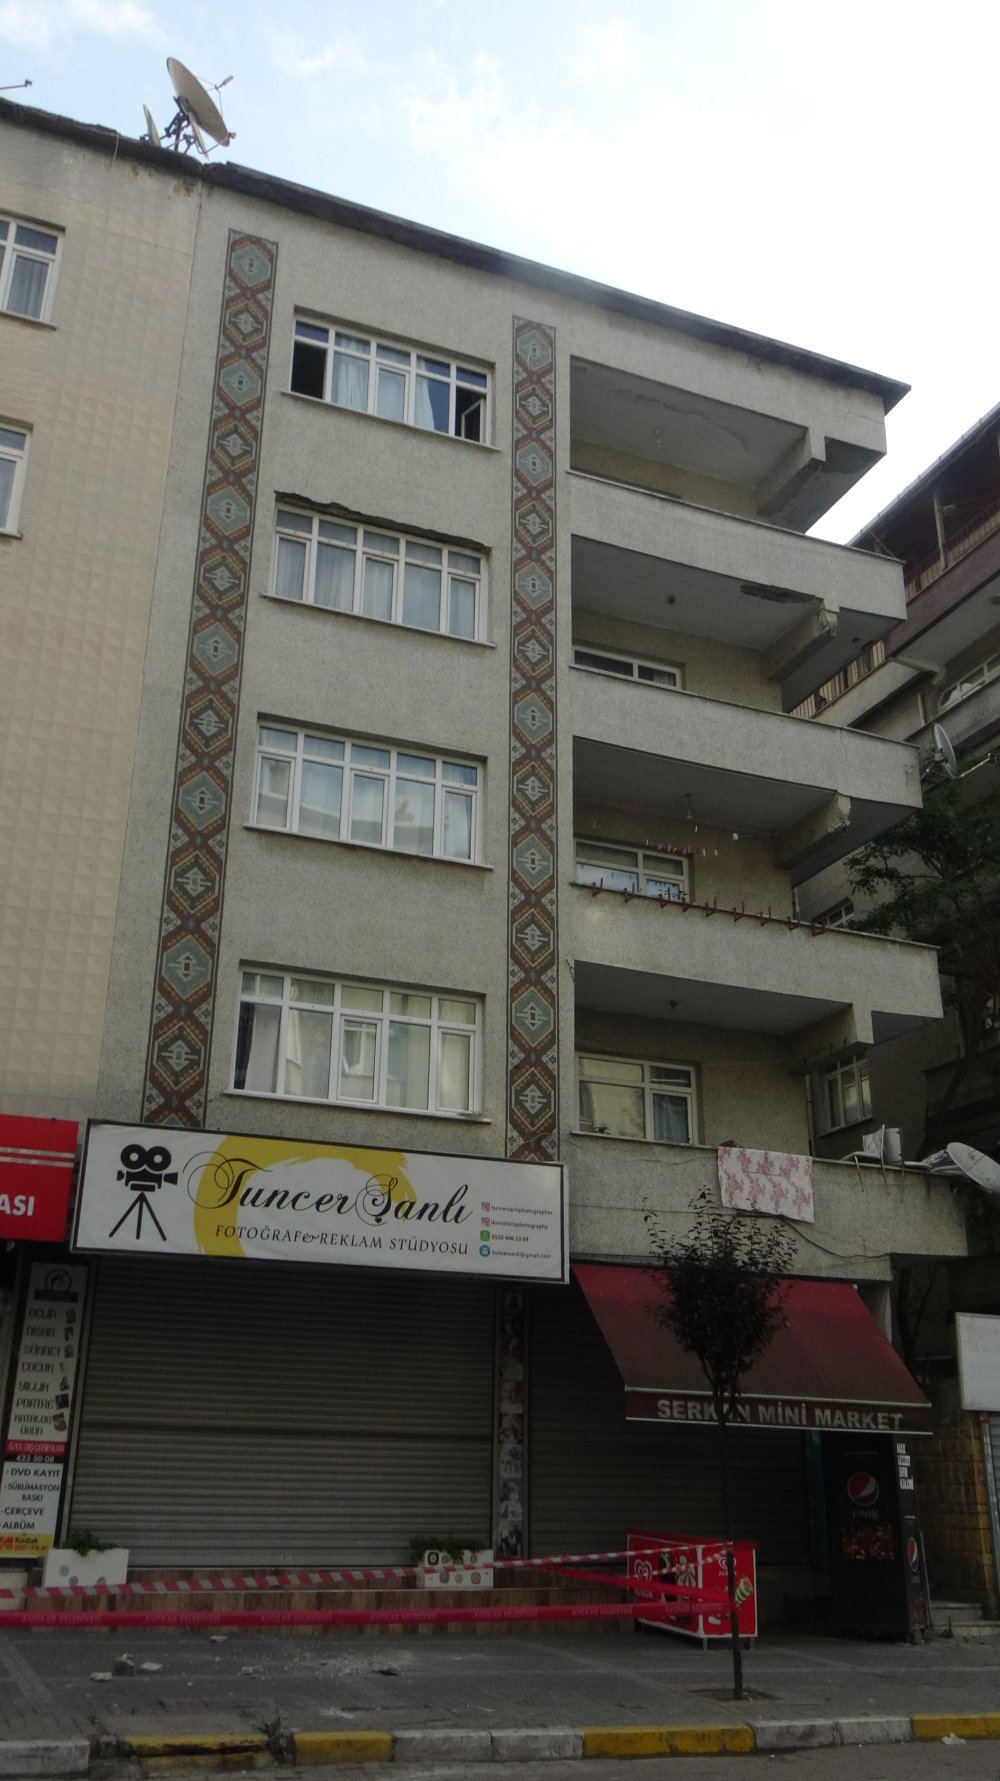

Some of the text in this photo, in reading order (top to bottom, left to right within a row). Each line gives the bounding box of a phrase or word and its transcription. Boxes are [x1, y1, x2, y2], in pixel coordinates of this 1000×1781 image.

[183, 1151, 473, 1227] Tuncer Şanlı
[0, 1194, 36, 1217] ASI
[388, 1236, 469, 1256] STÜDYOSU
[757, 1401, 808, 1425] MİNİ
[814, 1407, 903, 1430] MARKET
[10, 1468, 60, 1478] DVD KAYIT
[21, 1494, 44, 1502] BASKI
[15, 1535, 39, 1544] Kodak
